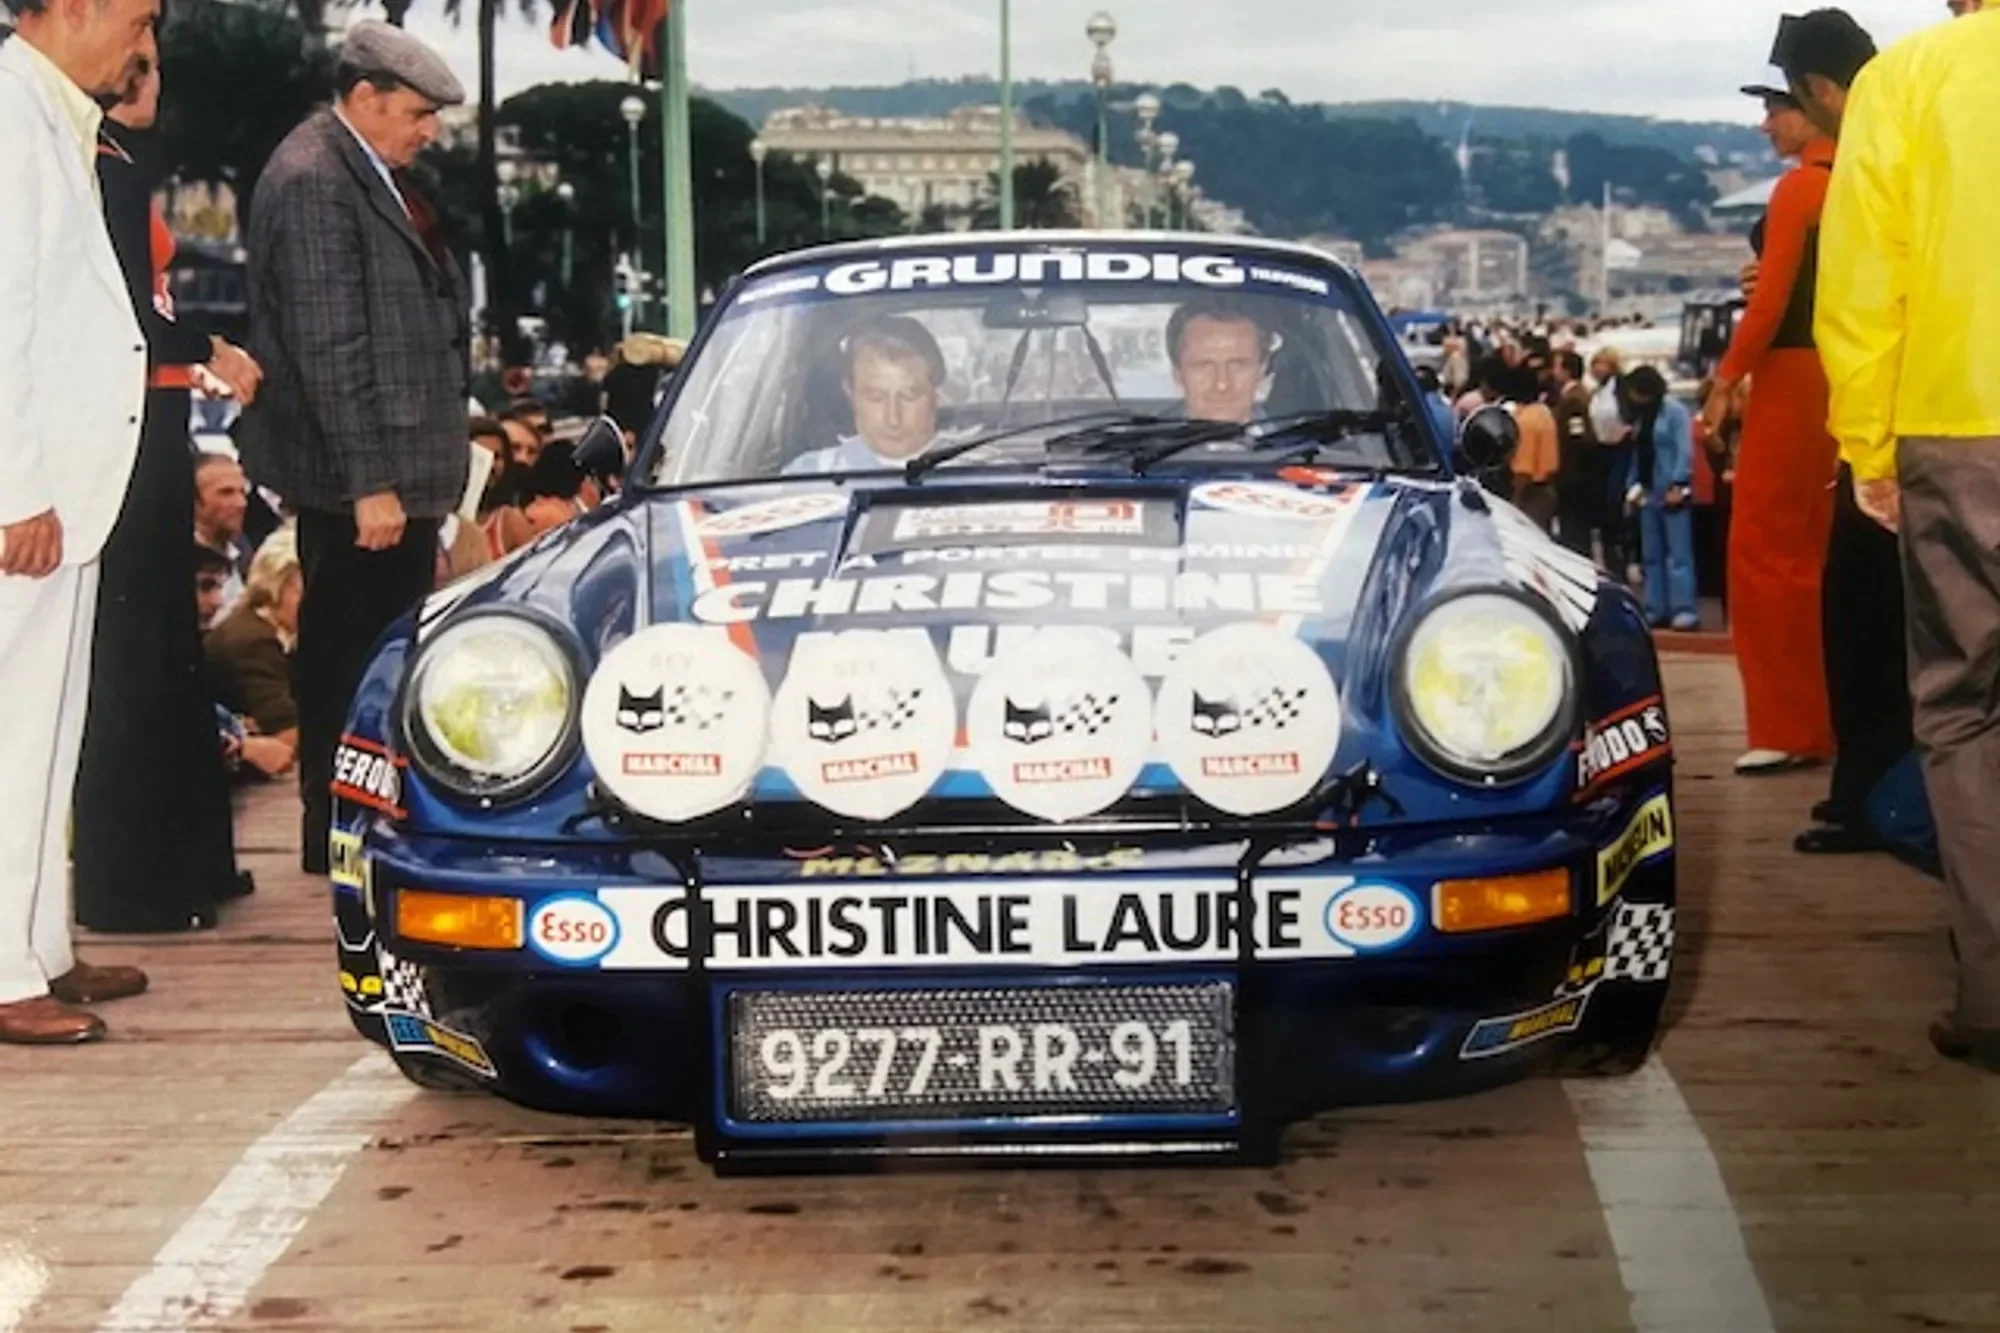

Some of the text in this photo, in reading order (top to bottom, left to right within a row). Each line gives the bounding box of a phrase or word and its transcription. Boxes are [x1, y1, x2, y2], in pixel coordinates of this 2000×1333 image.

[824, 253, 1246, 294] GRUNDIG
[693, 570, 1324, 623] CHRISTINE
[651, 890, 1301, 958] CHRISTINE LAURE
[760, 1019, 1193, 1099] 9277-RR-91
